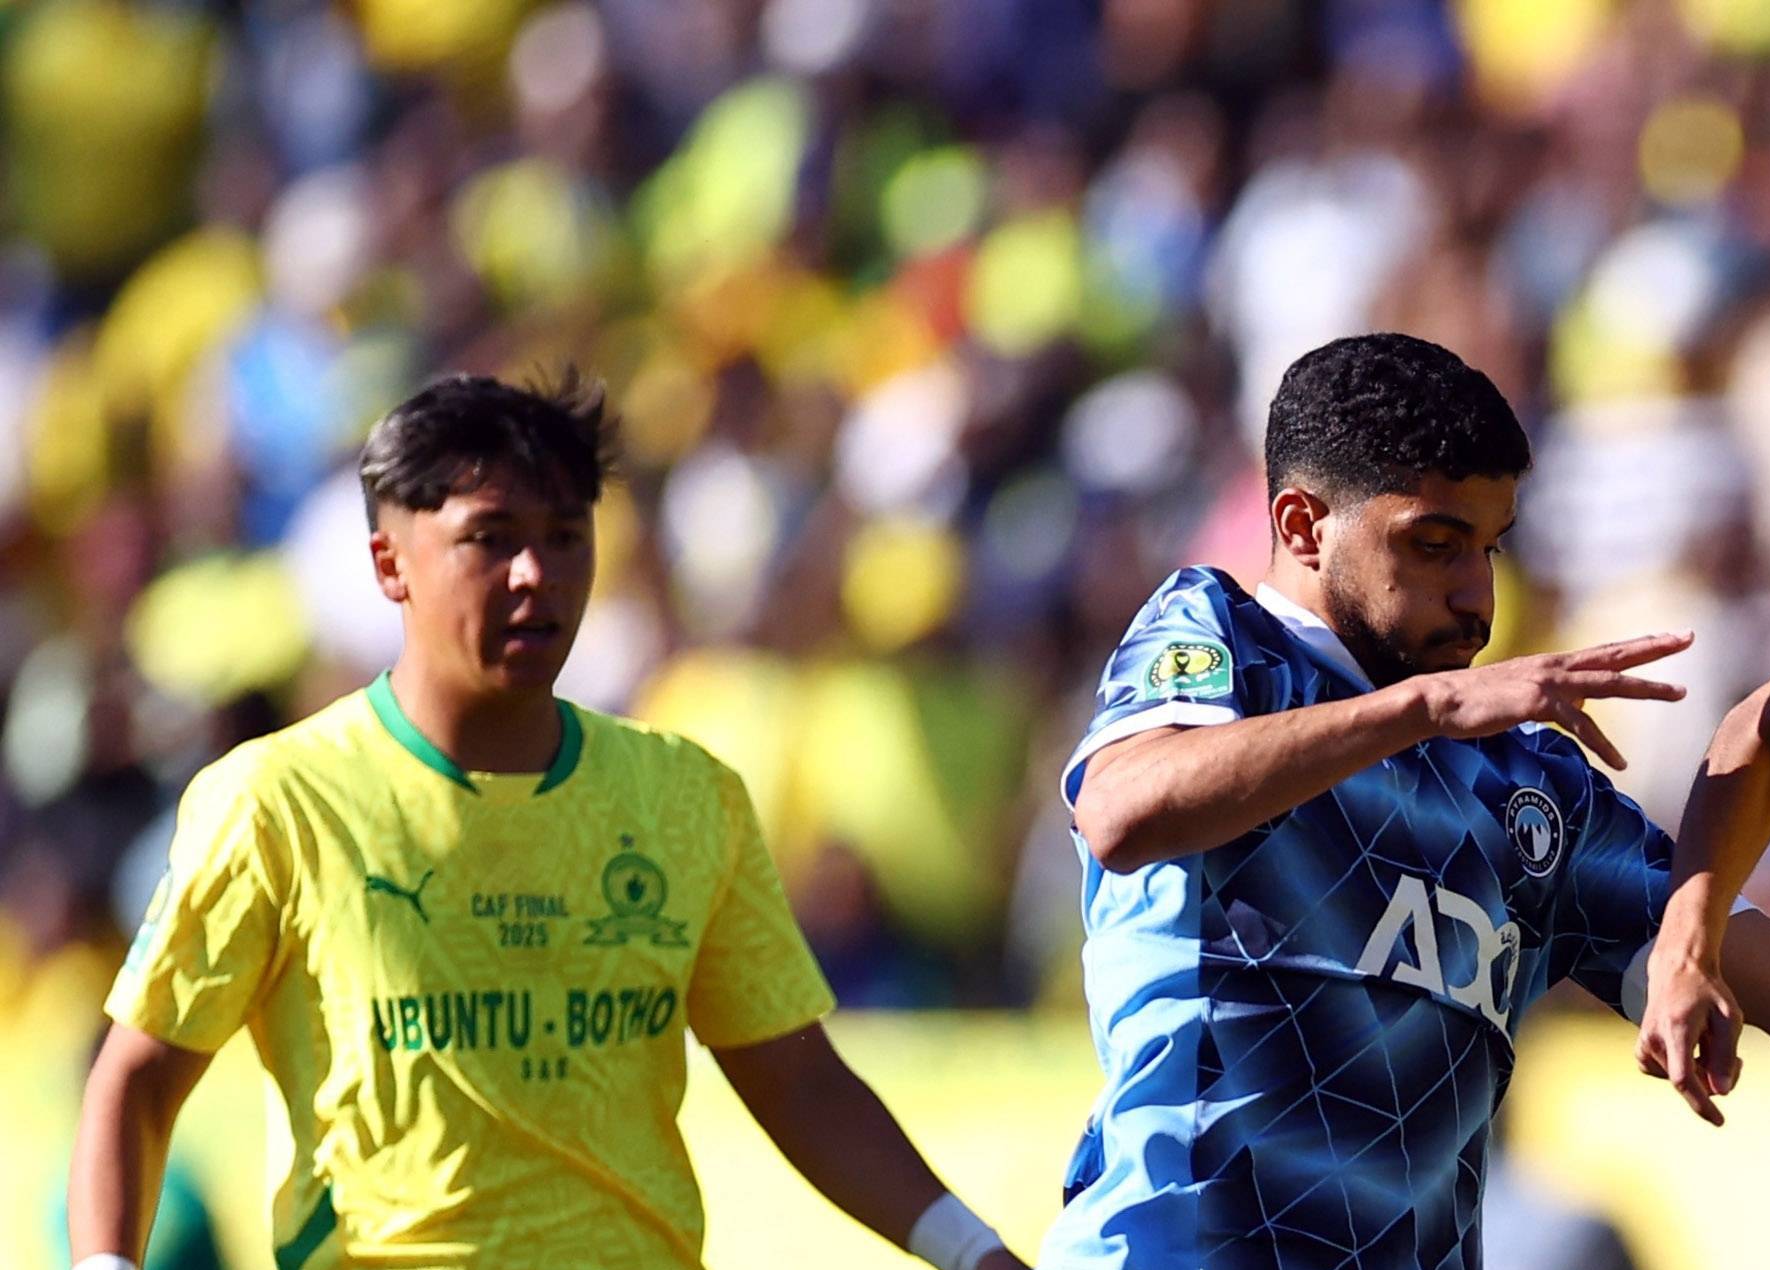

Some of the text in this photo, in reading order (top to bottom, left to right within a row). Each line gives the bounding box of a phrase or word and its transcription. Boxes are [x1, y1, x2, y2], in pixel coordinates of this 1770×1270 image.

[471, 892, 507, 918] CAF
[372, 989, 531, 1051] UBUNTU
[566, 986, 677, 1048] BOTHO
